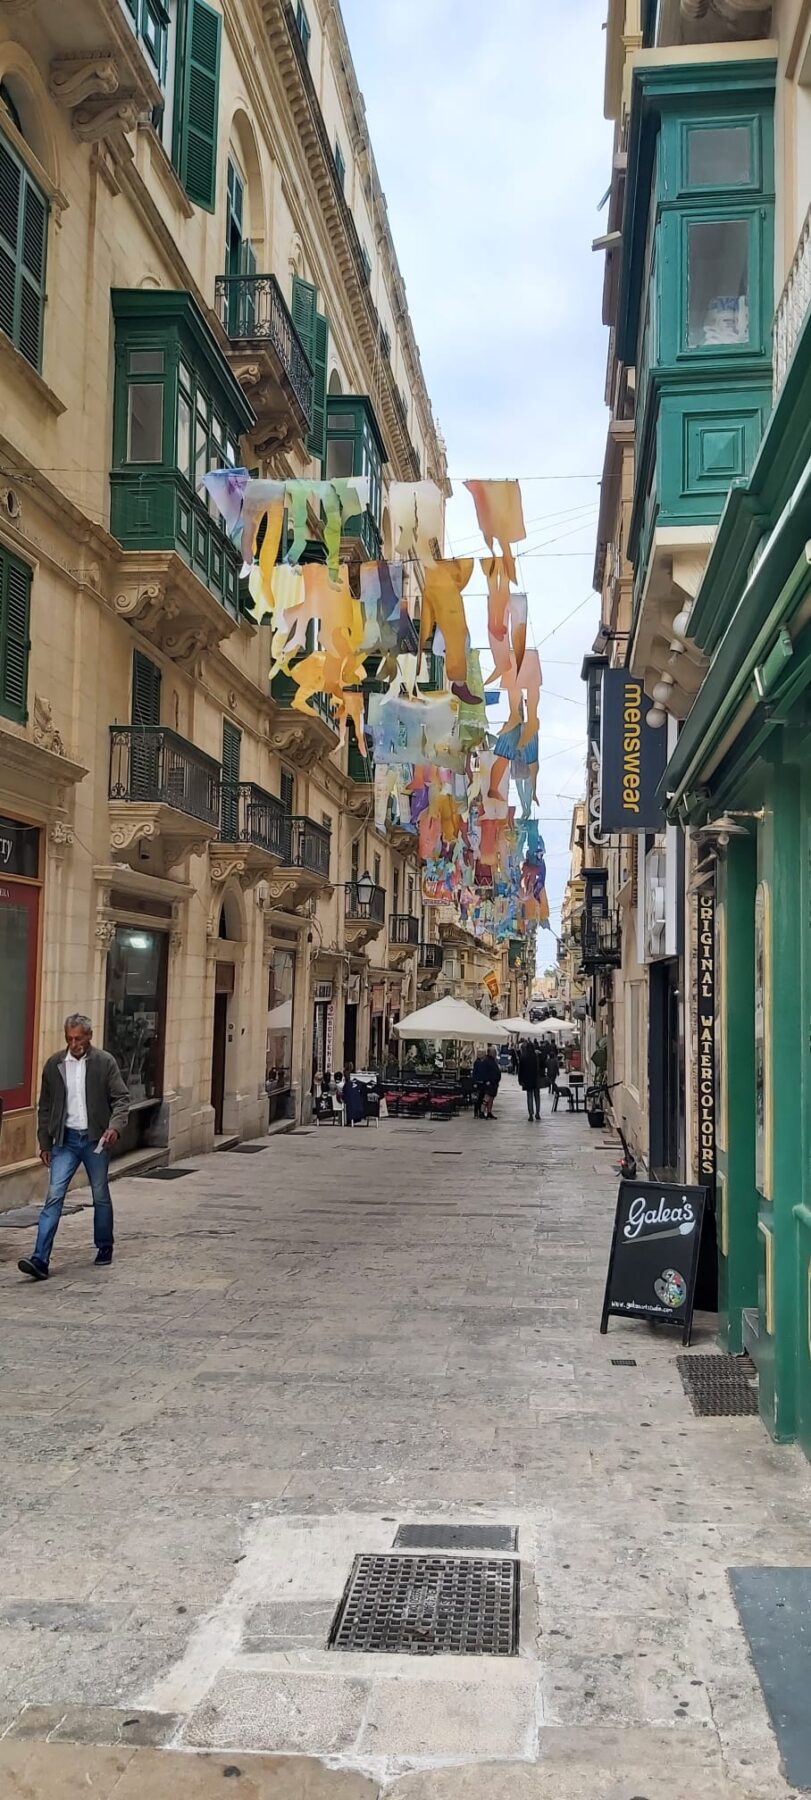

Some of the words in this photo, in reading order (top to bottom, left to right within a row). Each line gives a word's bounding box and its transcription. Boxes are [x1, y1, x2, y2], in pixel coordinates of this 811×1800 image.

[623, 684, 641, 813] menswear
[0, 838, 13, 864] ry
[700, 896, 713, 997] ORIGINAL
[701, 1015, 714, 1174] WATERCOLOURS
[623, 1195, 694, 1238] Galea's
